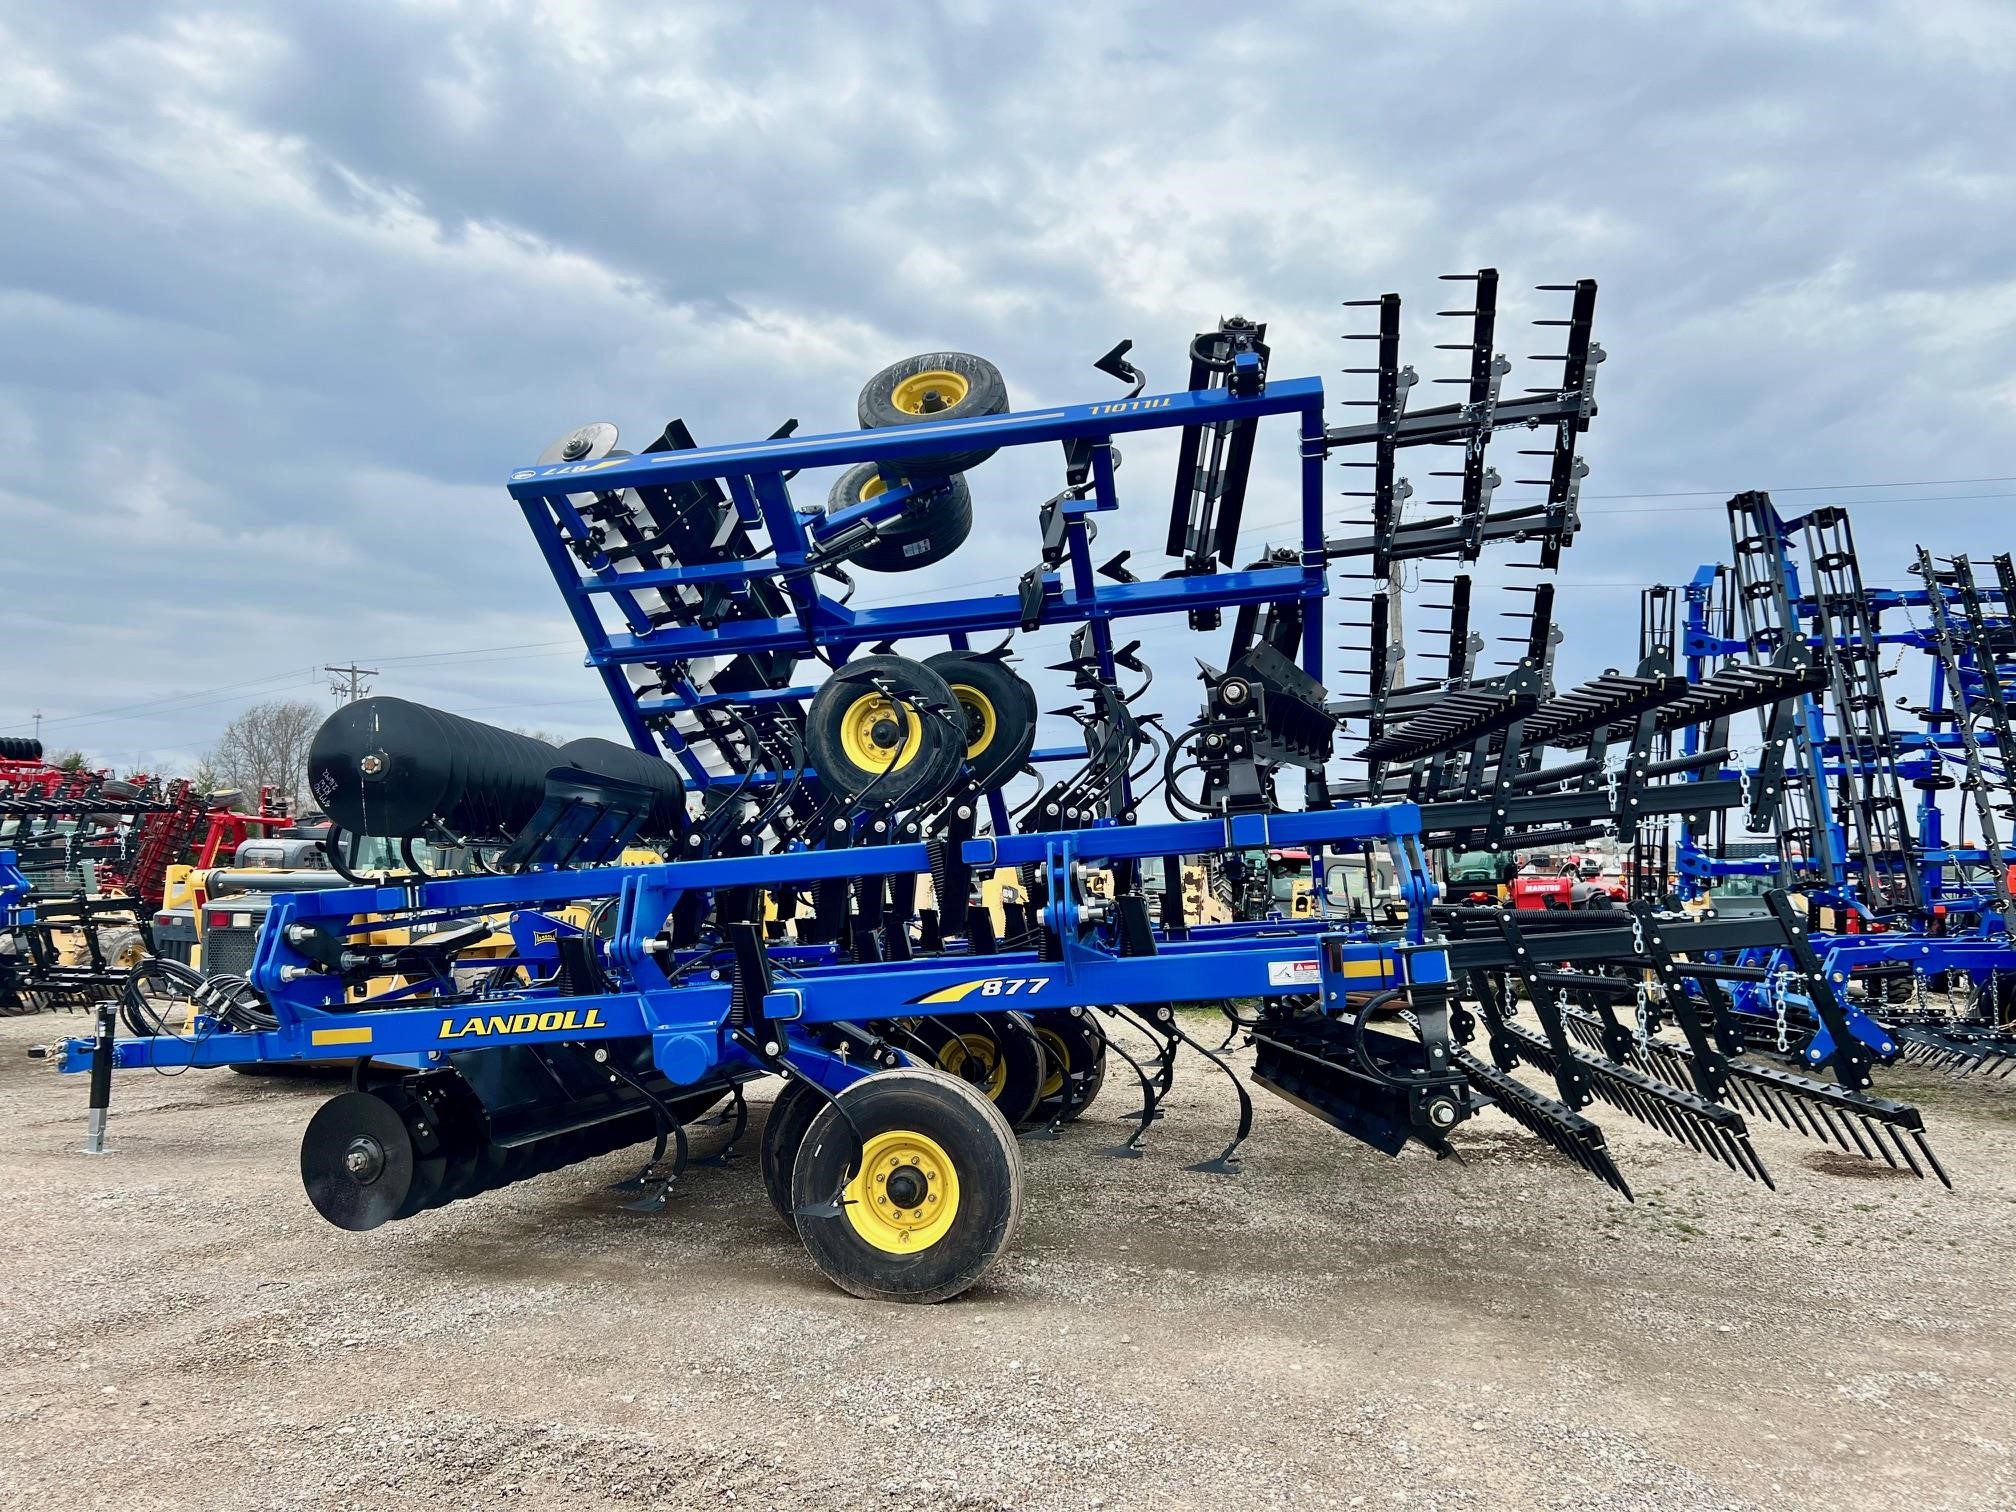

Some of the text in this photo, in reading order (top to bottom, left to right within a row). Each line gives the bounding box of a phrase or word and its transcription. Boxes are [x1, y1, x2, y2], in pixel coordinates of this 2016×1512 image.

[1088, 398, 1171, 415] TILLOLL
[540, 464, 589, 476] 877
[1525, 884, 1561, 893] MANITOU
[981, 977, 1050, 997] 877
[437, 1008, 607, 1040] LANDOLL
